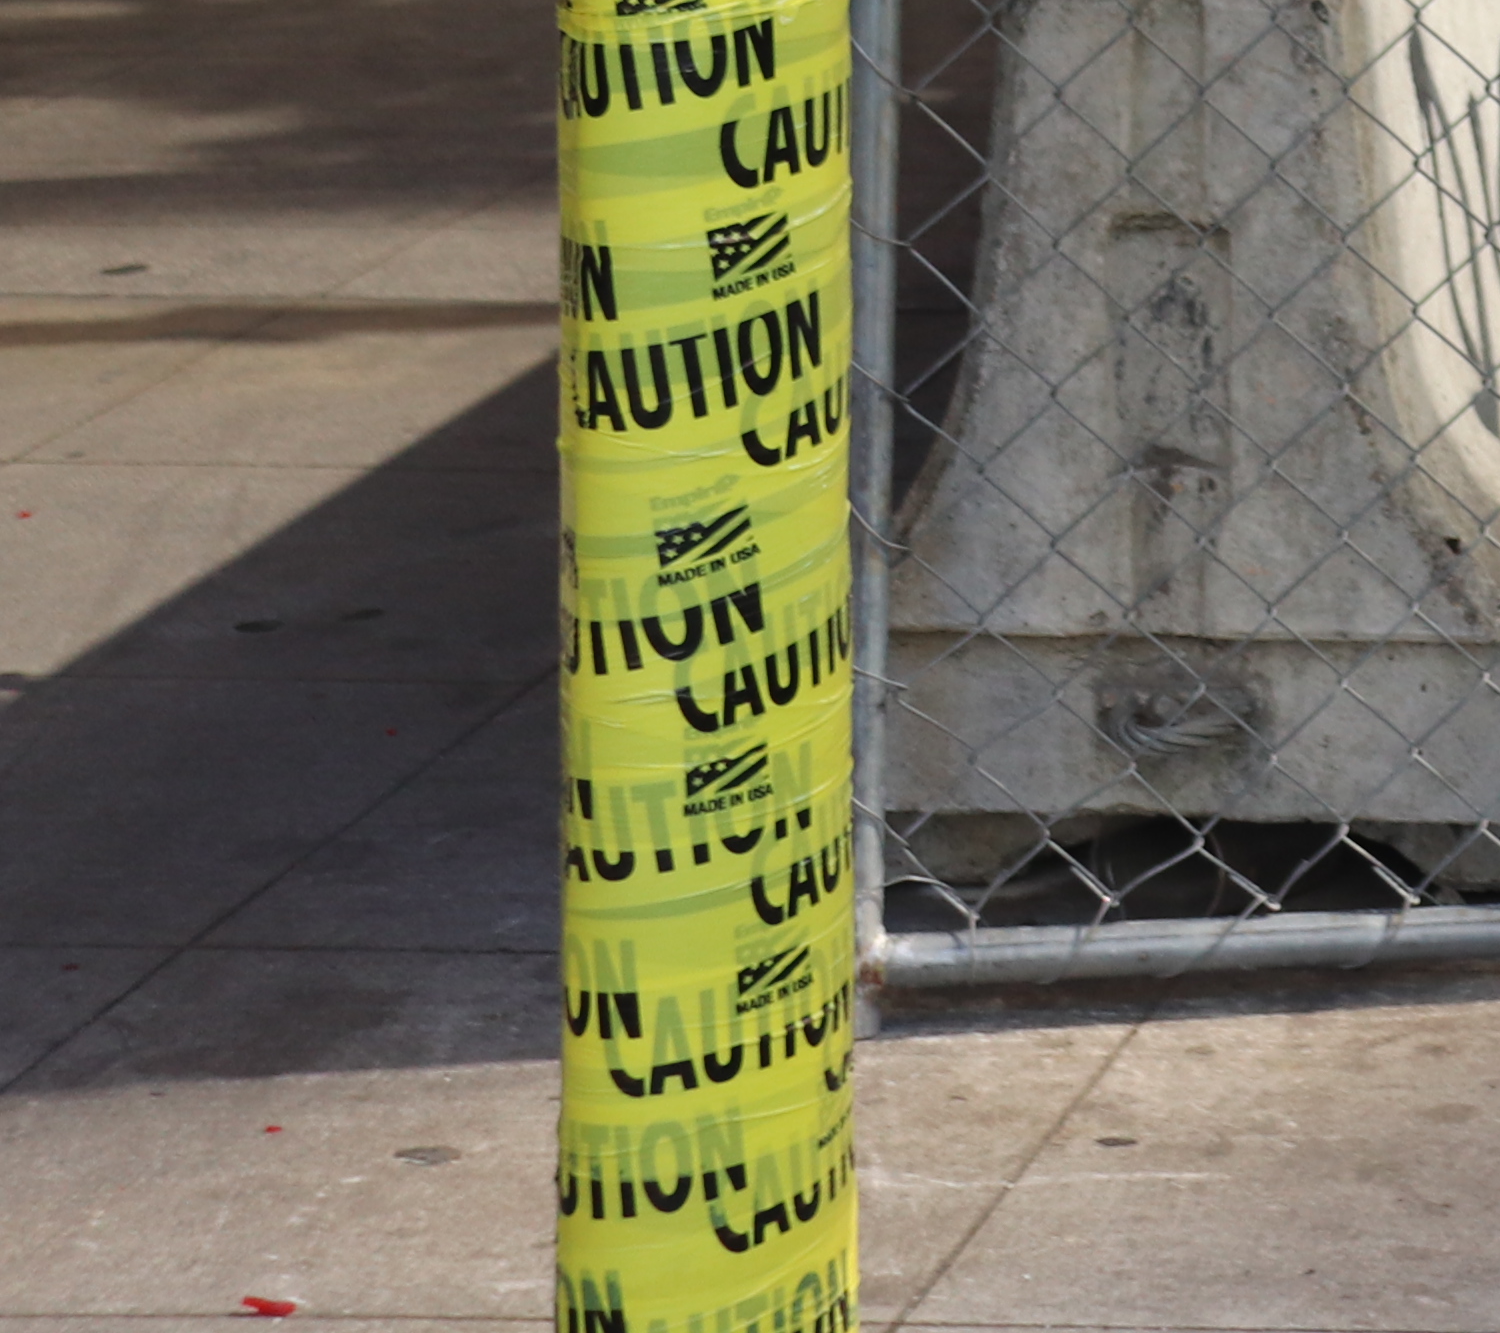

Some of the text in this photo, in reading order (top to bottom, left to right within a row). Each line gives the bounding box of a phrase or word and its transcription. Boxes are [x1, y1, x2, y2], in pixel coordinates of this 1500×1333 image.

[713, 261, 796, 301] MADE IN USA
[657, 542, 761, 588] MADE IN USA
[684, 783, 774, 817] MADE IN USA
[736, 972, 814, 1016] MADE IN USA
